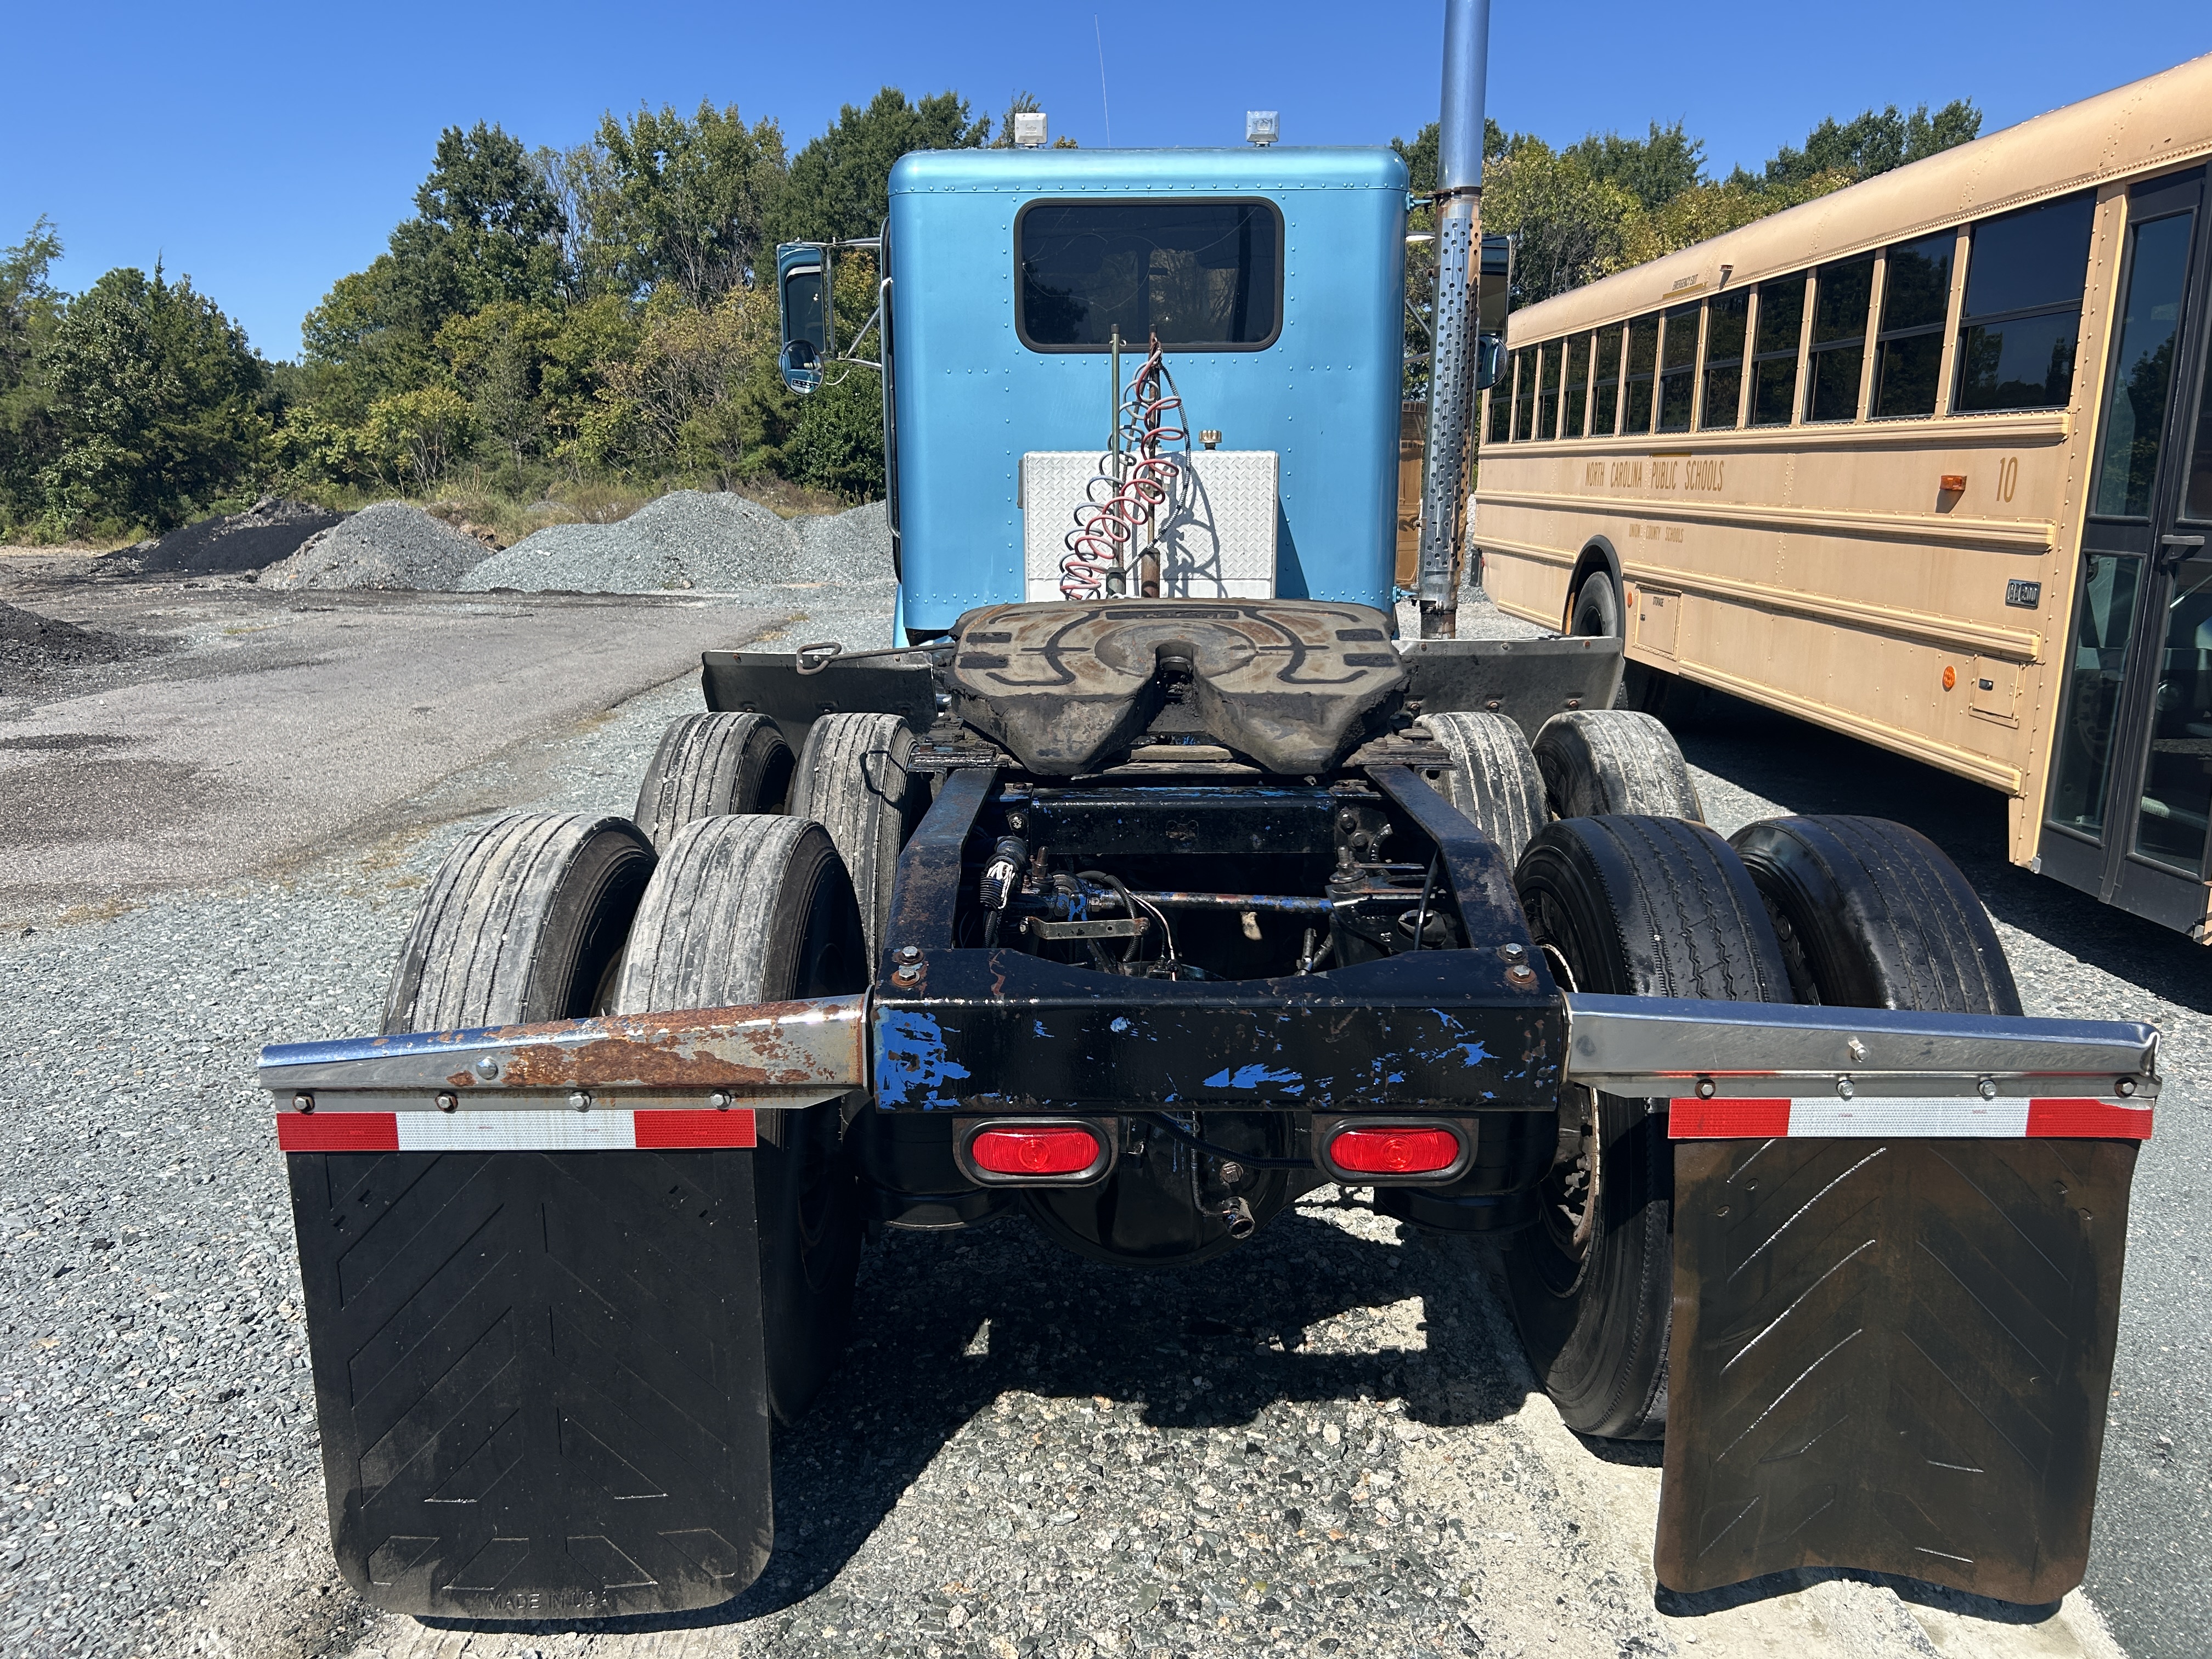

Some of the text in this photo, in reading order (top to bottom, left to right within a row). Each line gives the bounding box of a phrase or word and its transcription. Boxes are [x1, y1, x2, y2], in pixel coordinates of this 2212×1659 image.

[1585, 460, 1724, 492] NORTH CAROLINA PUBLIC SCHOOLS
[1996, 456, 2018, 503] 10
[1629, 523, 1684, 543] UNION COUNTY SCHOOLS
[487, 1590, 611, 1610] MADE IN USA
